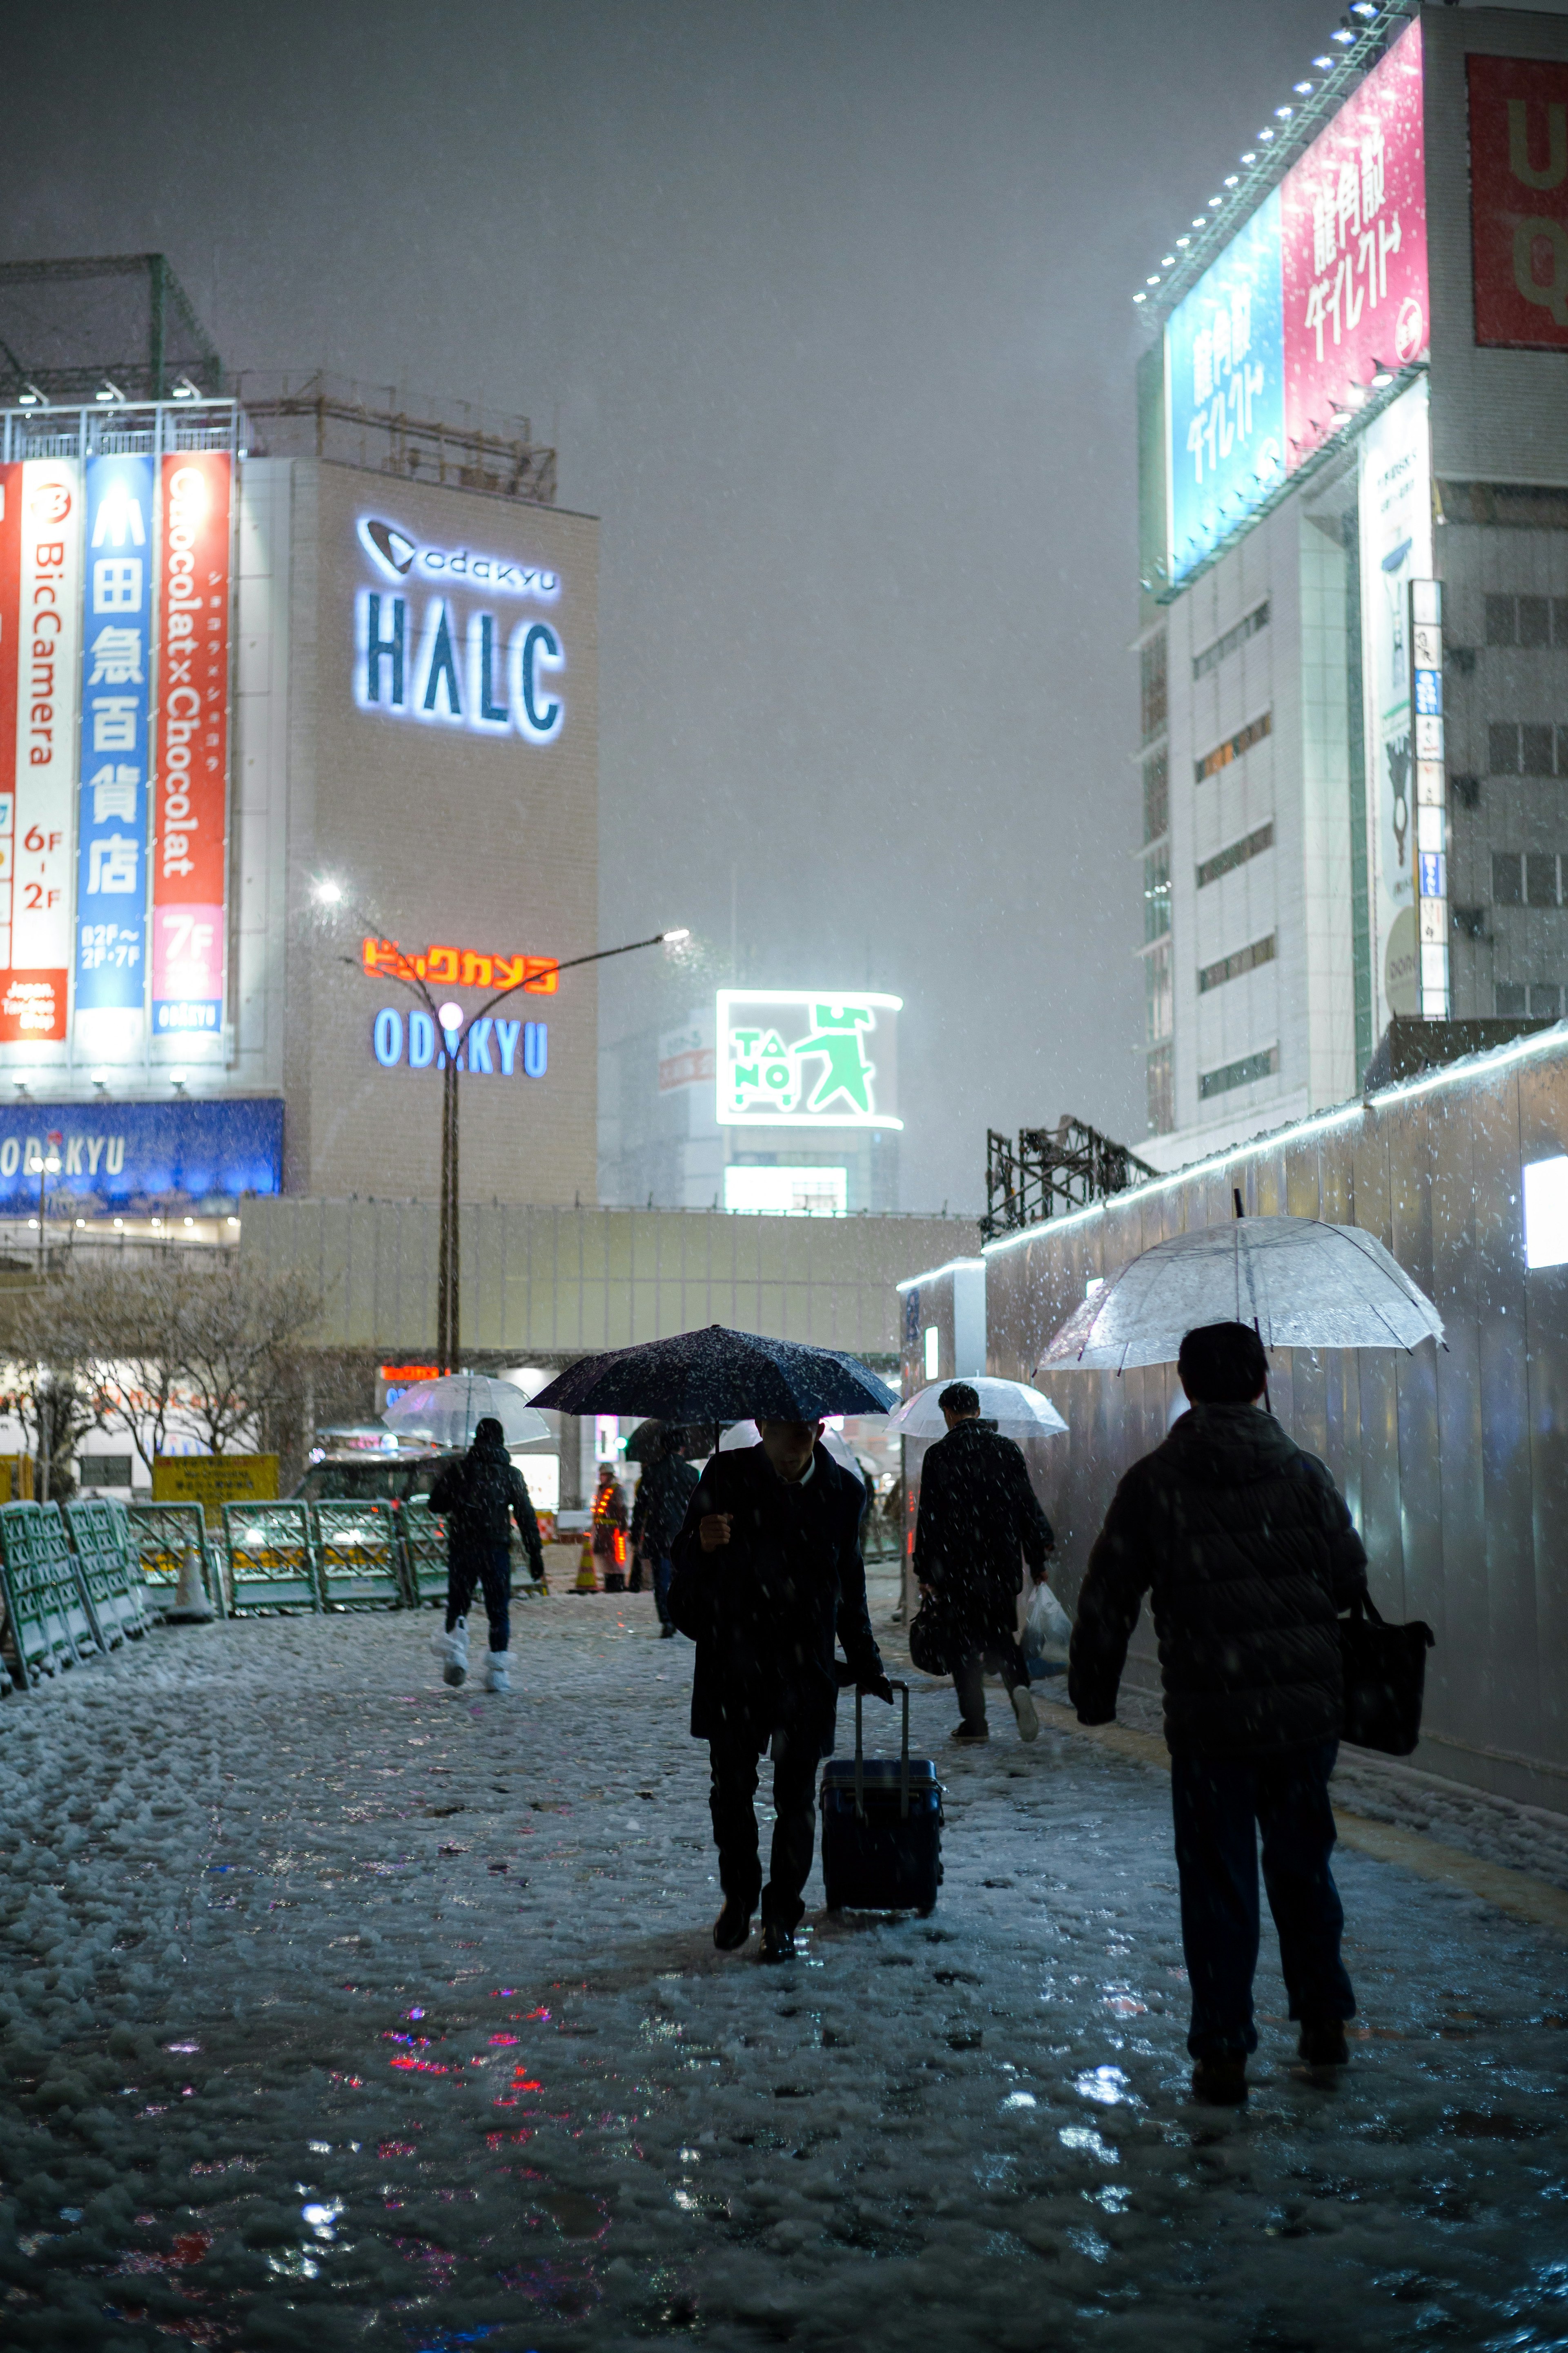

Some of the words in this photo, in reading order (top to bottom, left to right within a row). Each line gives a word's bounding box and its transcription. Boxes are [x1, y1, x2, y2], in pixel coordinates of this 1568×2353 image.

[1304, 210, 1402, 363] ダイレクト
[425, 549, 558, 591] odakyu
[29, 542, 64, 767] BicCamera
[367, 591, 559, 731] HALC
[86, 488, 146, 895] 小田急百貨店
[24, 824, 62, 852] 6F
[24, 883, 60, 910] 2F
[163, 913, 214, 960] 7F
[363, 937, 559, 995] ビックカメラ
